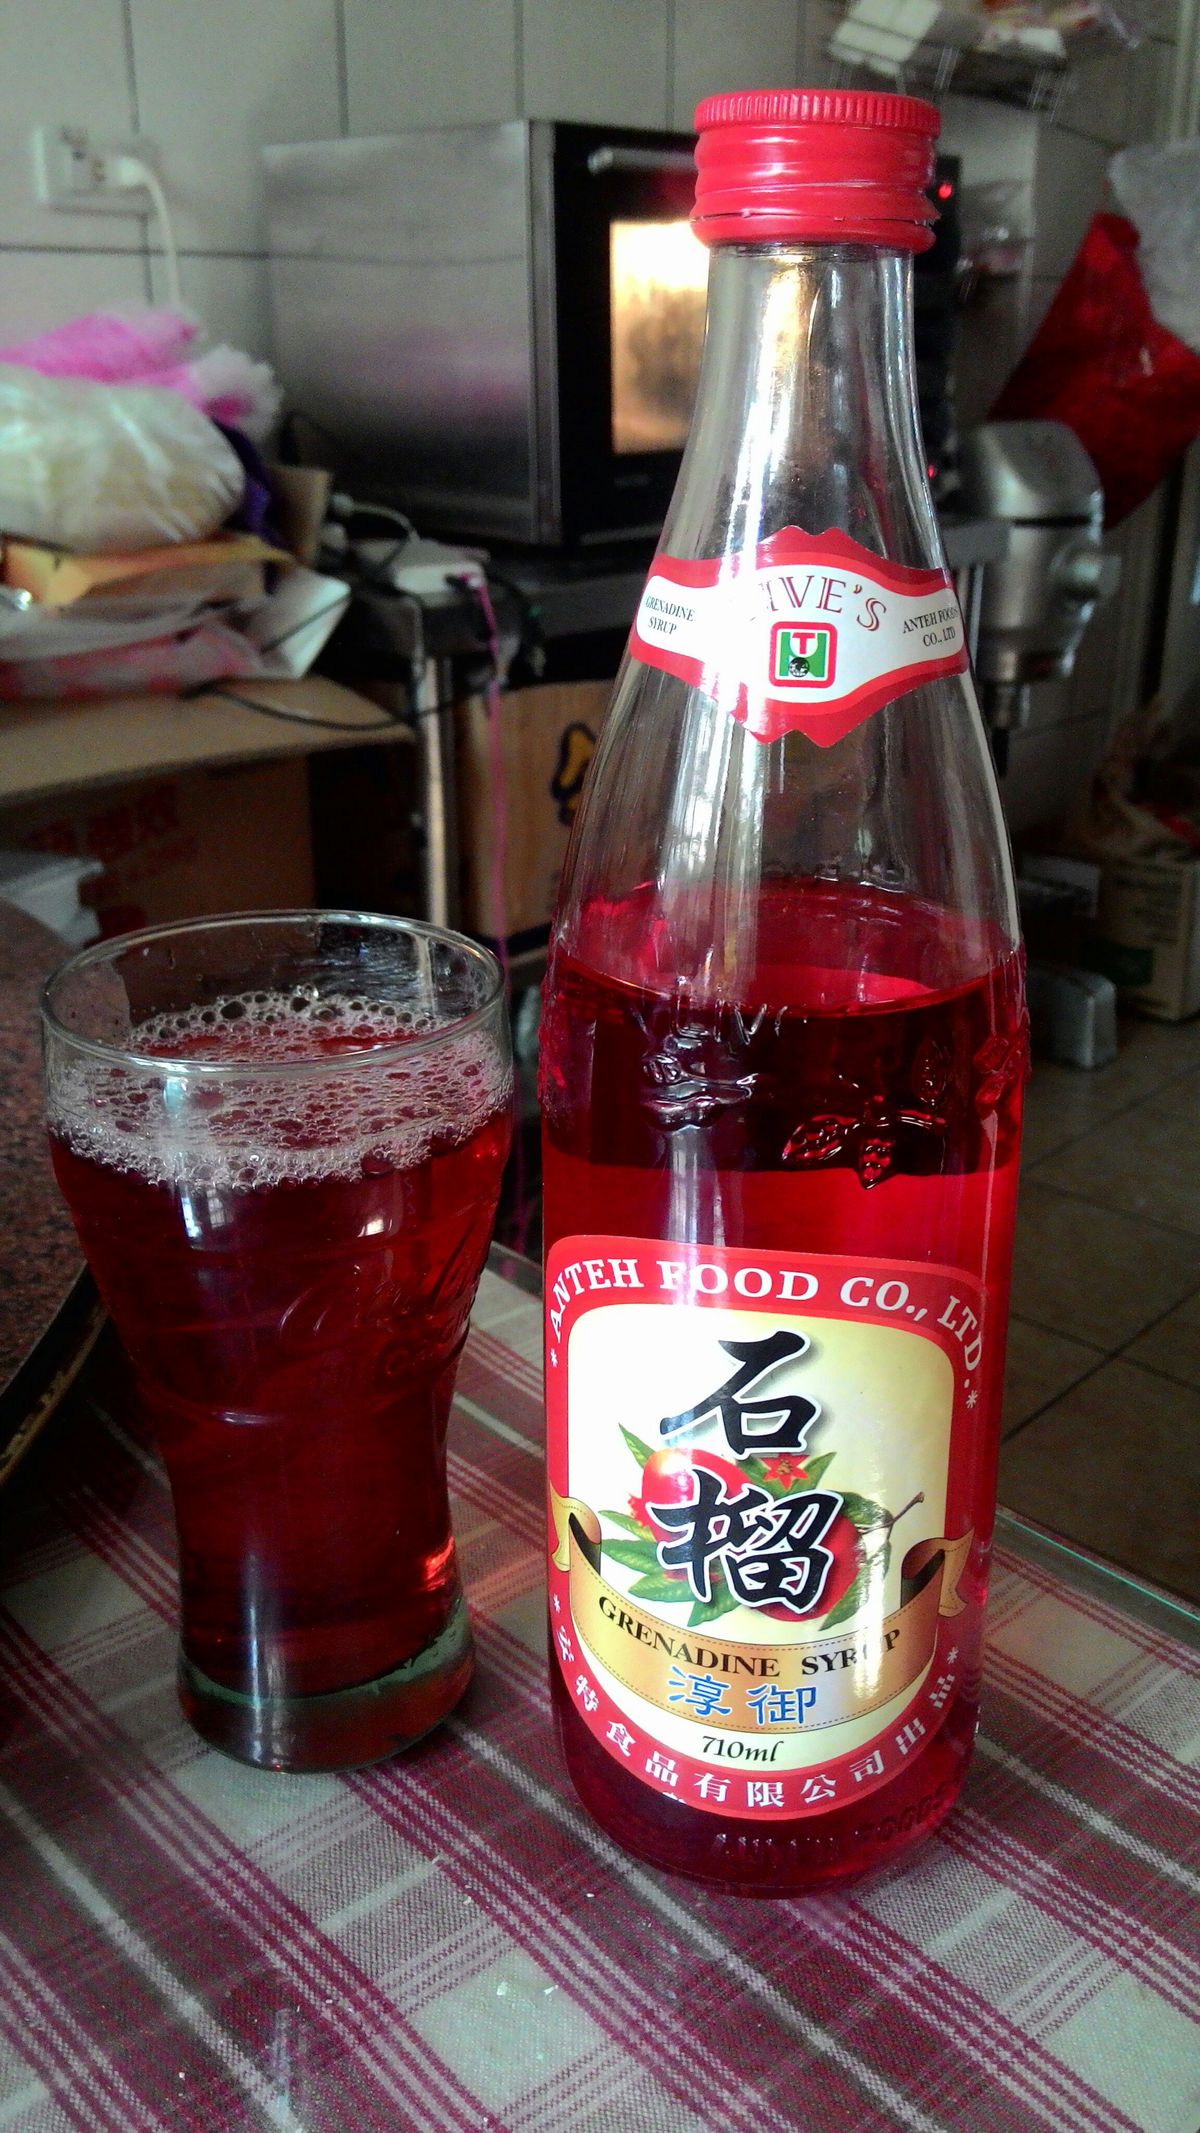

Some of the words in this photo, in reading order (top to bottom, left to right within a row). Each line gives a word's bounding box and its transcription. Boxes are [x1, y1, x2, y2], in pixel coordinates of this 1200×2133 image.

[645, 595, 695, 622] GRENADINE
[749, 574, 887, 632] IVE'S
[902, 611, 938, 634] ANTEH
[647, 615, 678, 635] SYRUP
[550, 1258, 644, 1342] ANTEH
[656, 1260, 819, 1300] FOOD
[838, 1276, 929, 1322] CO.,
[936, 1294, 983, 1389] LTD.
[598, 1595, 781, 1678] GRENADINE
[800, 1627, 902, 1677] SYRP
[667, 1665, 818, 1727] 淳御
[701, 1734, 785, 1763] 710ml
